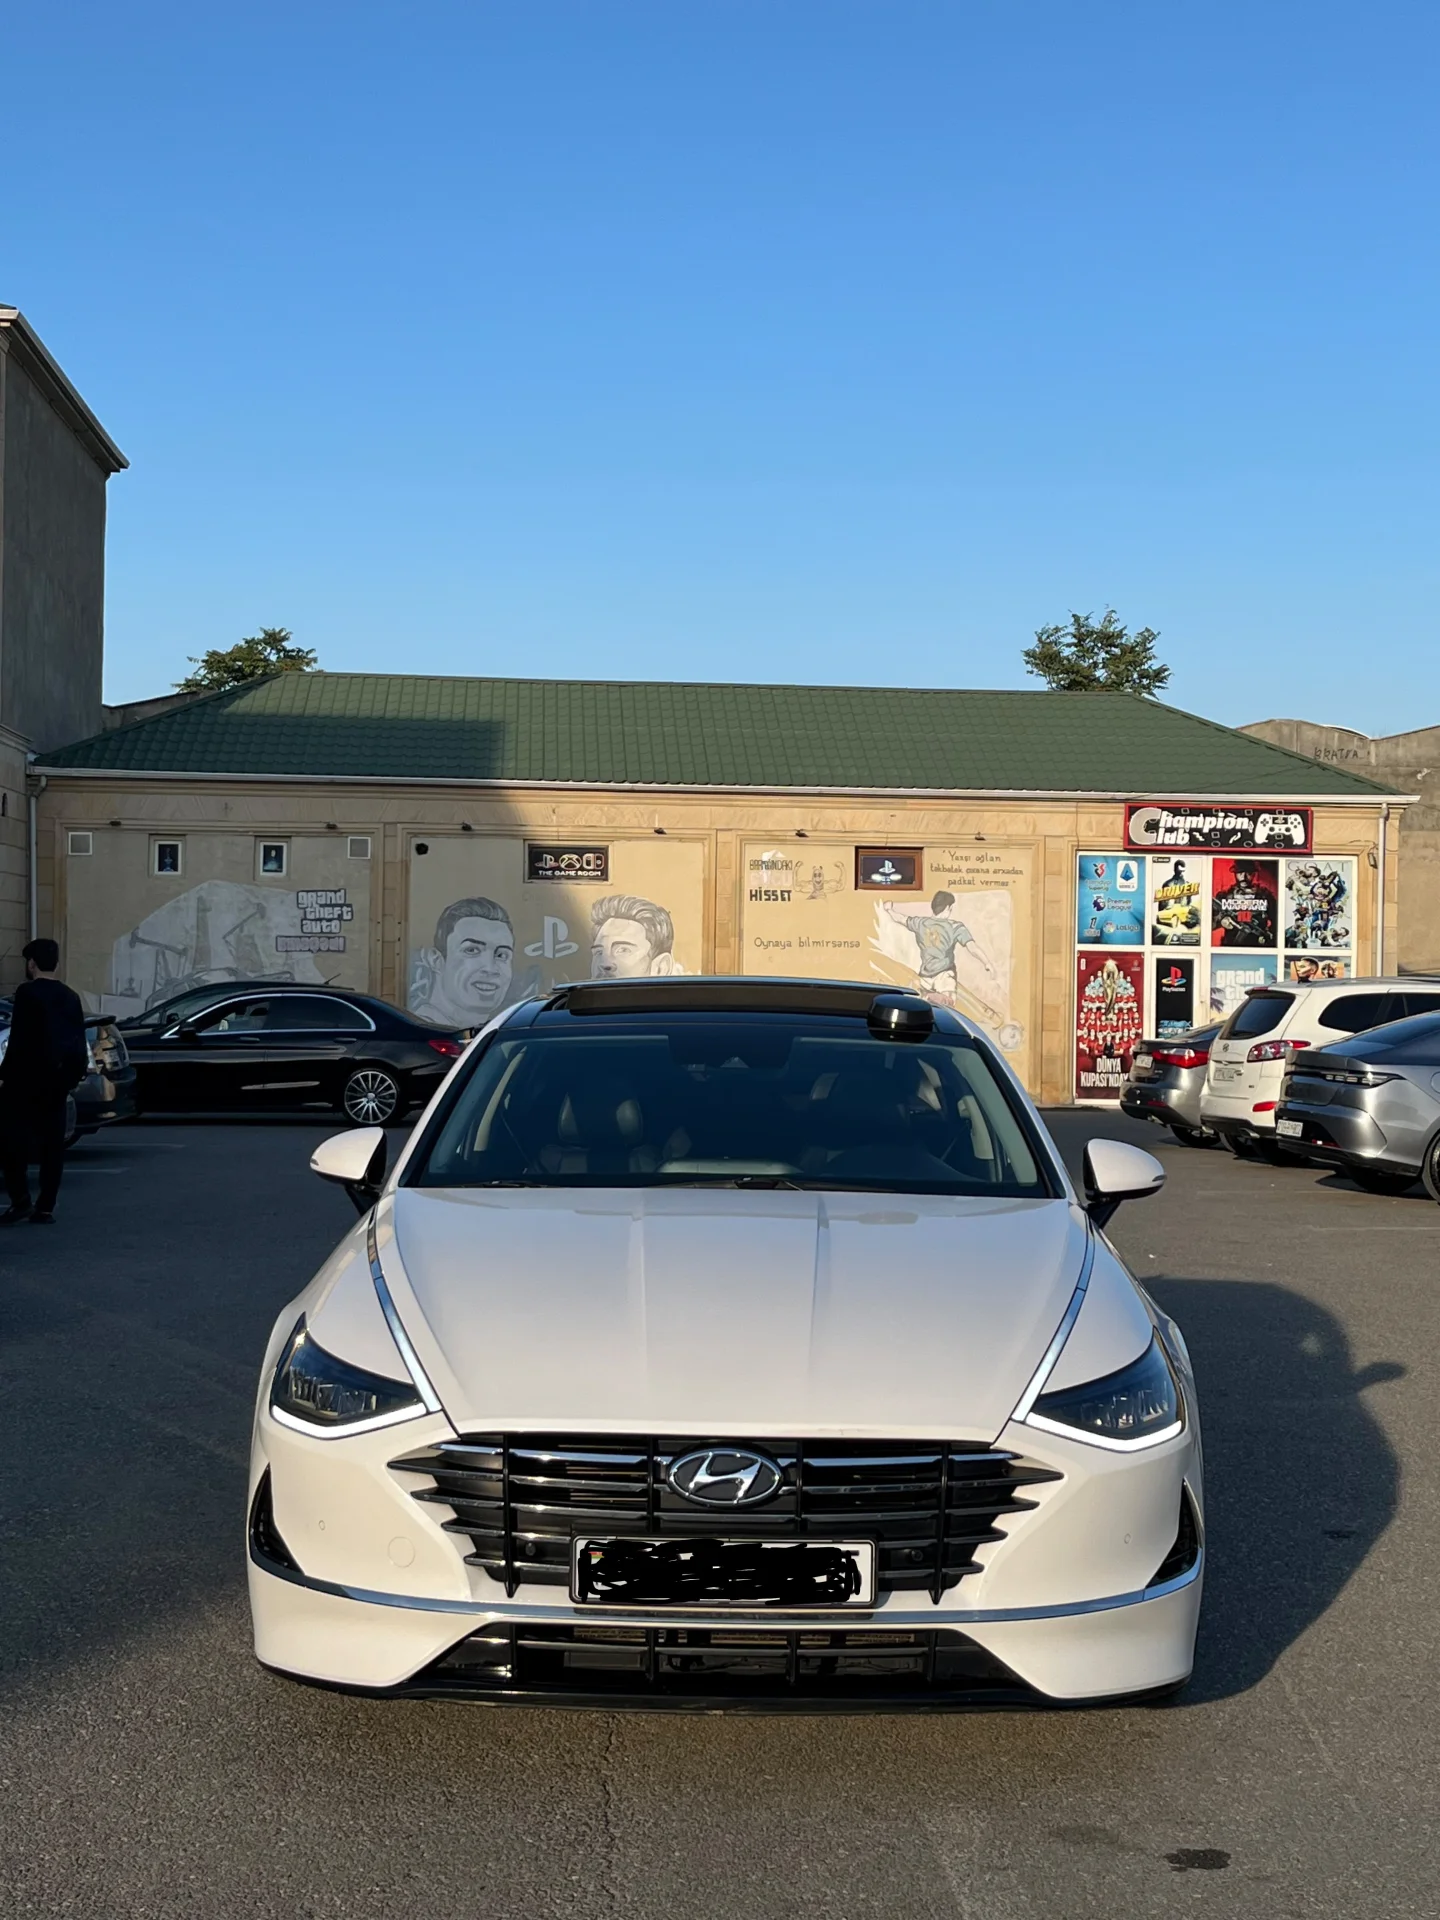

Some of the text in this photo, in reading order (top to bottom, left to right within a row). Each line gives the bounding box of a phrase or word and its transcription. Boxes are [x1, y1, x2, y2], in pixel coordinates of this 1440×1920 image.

[1129, 807, 1250, 845] Champion
[298, 888, 346, 908] grand
[305, 905, 352, 919] theft
[302, 920, 340, 933] auto
[754, 937, 792, 950] Oynaya
[1216, 968, 1264, 988] grand
[1096, 1055, 1121, 1073] DÜNYA
